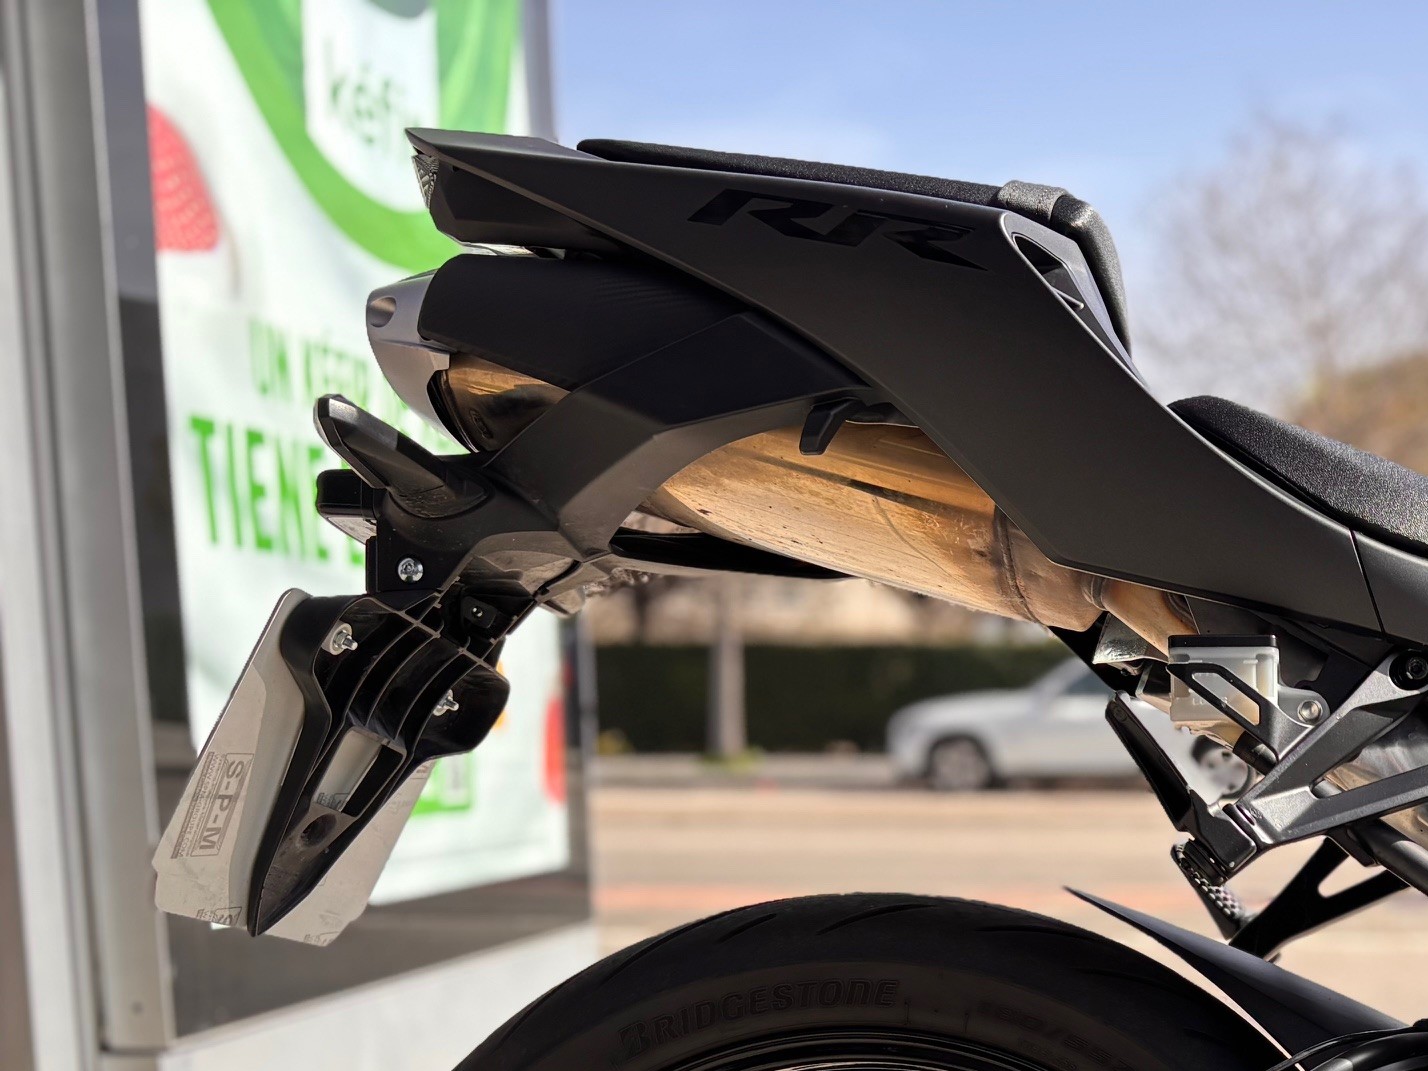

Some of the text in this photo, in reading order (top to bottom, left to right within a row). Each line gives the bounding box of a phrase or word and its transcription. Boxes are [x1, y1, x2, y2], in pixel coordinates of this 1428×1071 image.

[687, 188, 989, 271] RR
[200, 759, 244, 850] S-P-M
[617, 977, 900, 1056] BRIDGESTONE
